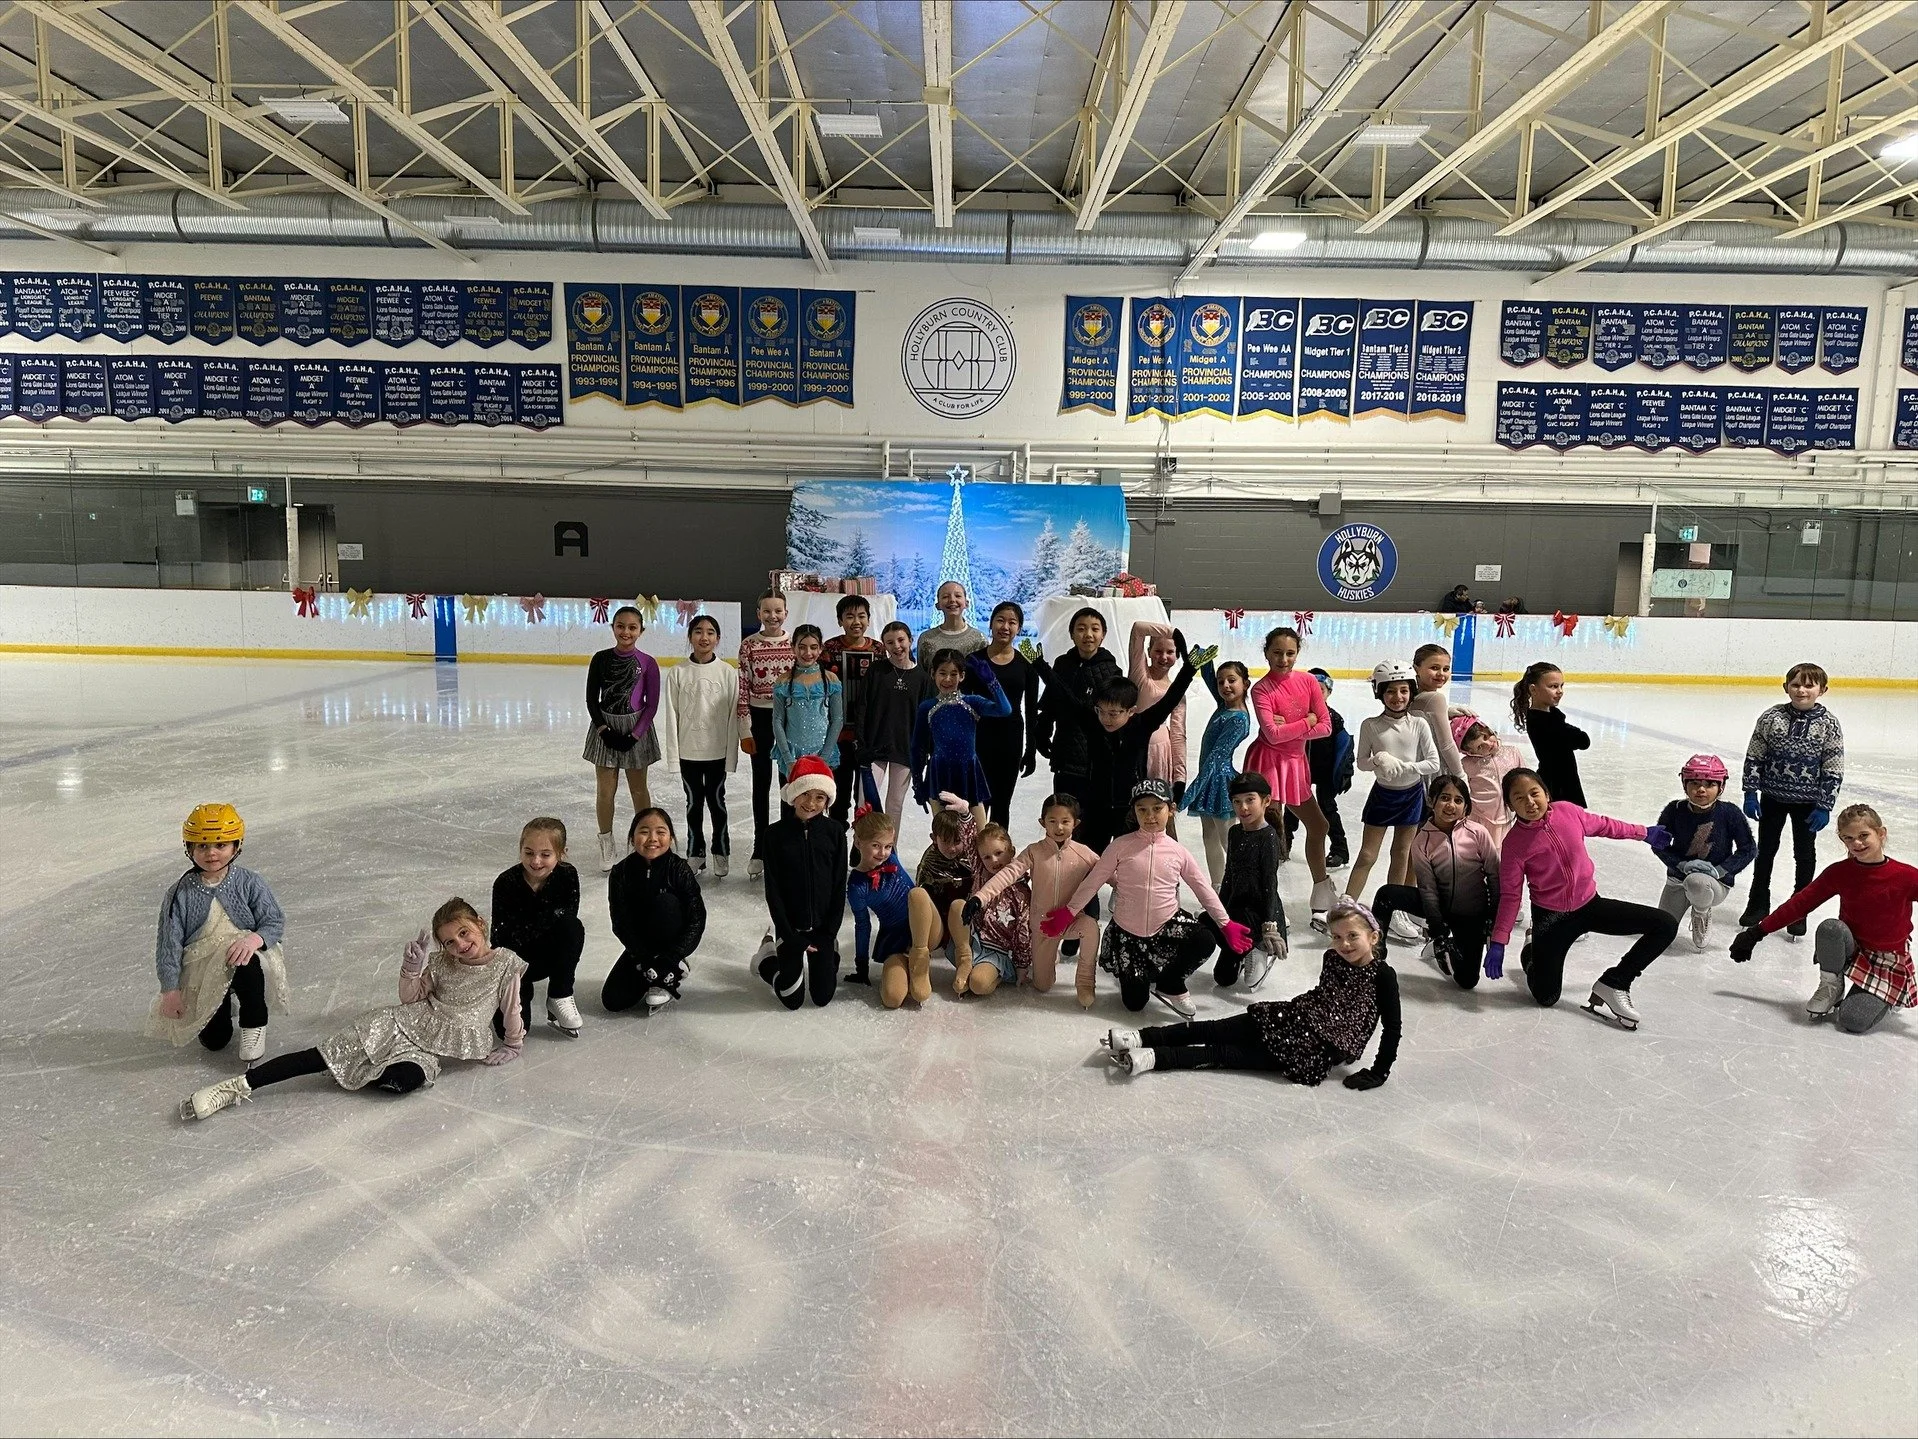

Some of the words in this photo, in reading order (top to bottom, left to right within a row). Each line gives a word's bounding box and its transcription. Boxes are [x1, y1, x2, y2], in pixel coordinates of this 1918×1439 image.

[14, 278, 50, 286] P.C.A.H.A.
[56, 278, 93, 287] P.C.A.H.A.
[103, 280, 140, 288] P.C.A.H.A.
[148, 281, 184, 290] P.C.A.H.A.
[284, 284, 320, 292] P.C.A.H.A.
[376, 286, 412, 294] P.C.A.H.A.
[422, 286, 458, 294] P.C.A.H.A.
[1507, 306, 1542, 314] P.C.A.H.A.
[1552, 308, 1588, 316] P.C.A.H.A.
[1689, 310, 1724, 318] P.C.A.H.A.
[1247, 309, 1294, 331] BC
[1364, 309, 1410, 329] BC
[1422, 310, 1468, 331] BC
[1736, 312, 1771, 320] P.C.A.H.A.
[1826, 312, 1862, 320] P.C.A.H.A.
[1307, 314, 1354, 336] BC
[910, 310, 948, 360] HOLLYBURN
[952, 308, 998, 333] COUNTRY
[996, 336, 1008, 362] CLUB
[576, 342, 604, 351] Bantam
[607, 342, 612, 351] A
[634, 342, 662, 352] Bantam
[665, 342, 670, 352] A
[694, 345, 721, 354] Bantam
[724, 346, 730, 354] A
[751, 346, 764, 356] Pee
[768, 347, 782, 356] Wee
[784, 348, 790, 356] A
[1248, 344, 1260, 352] Pee
[1263, 344, 1278, 352] Wee
[1281, 344, 1291, 353] AA
[1362, 344, 1386, 352] Bantam
[1389, 344, 1402, 352] Tier
[1404, 344, 1408, 352] 2
[1422, 345, 1442, 356] Midget
[1444, 346, 1456, 354] Tier
[1458, 346, 1461, 354] 2
[810, 348, 834, 358] Bantam
[837, 349, 842, 358] A
[1304, 346, 1328, 357] Midget
[1330, 348, 1344, 356] Tier
[571, 354, 619, 363] PROVINCIAL
[631, 355, 678, 364] PROVINCIAL
[688, 358, 736, 368] PROVINCIAL
[1072, 356, 1100, 366] Midget
[1166, 356, 1172, 364] A
[1190, 356, 1217, 364] Midget
[21, 360, 57, 368] P.C.A.H.A.
[66, 360, 102, 368] P.C.A.H.A.
[112, 361, 148, 370] P.C.A.H.A.
[158, 362, 194, 370] P.C.A.H.A.
[204, 363, 239, 371] P.C.A.H.A.
[571, 364, 620, 373] CHAMPIONS
[746, 360, 794, 370] PROVINCIAL
[803, 362, 849, 370] PROVINCIAL
[339, 366, 376, 374] P.C.A.H.A.
[384, 368, 420, 376] P.C.A.H.A.
[430, 368, 466, 376] P.C.A.H.A.
[474, 368, 511, 377] P.C.A.H.A.
[631, 364, 679, 374] CHAMPIONS
[690, 368, 736, 376] CHAMPIONS
[1068, 368, 1115, 378] PROVINCIAL
[1183, 368, 1232, 376] PROVINCIAL
[1301, 369, 1350, 378] CHAMPIONS
[520, 370, 557, 378] P.C.A.H.A.
[746, 370, 794, 378] CHAMPIONS
[802, 371, 849, 380] CHAMPIONS
[1242, 370, 1292, 378] CHAMPIONS
[1416, 372, 1465, 382] CHAMPIONS
[574, 376, 618, 386] 1993-1994
[632, 380, 678, 390] 1994-1995
[690, 378, 735, 388] 1995-1996
[1068, 377, 1116, 387] CHAMPIONS
[1132, 378, 1177, 386] CHAMPIONS
[1182, 376, 1232, 385] CHAMPIONS
[748, 383, 794, 391] 1999-2000
[803, 384, 848, 392] 1999-2000
[1068, 391, 1112, 400] 999-2000
[1242, 392, 1291, 400] 2005-2006
[1301, 388, 1346, 397] 2008-2009
[1361, 392, 1404, 400] 2017-2018
[1183, 394, 1230, 402] 2001-2002
[1416, 393, 1462, 402] 2018-2019
[938, 400, 954, 408] CLUB
[971, 398, 984, 407] LIFE
[554, 521, 588, 556] A
[1334, 526, 1385, 544] HOLLYBURN
[1337, 586, 1374, 600] HUSKIES
[1132, 780, 1166, 798] PARIS
